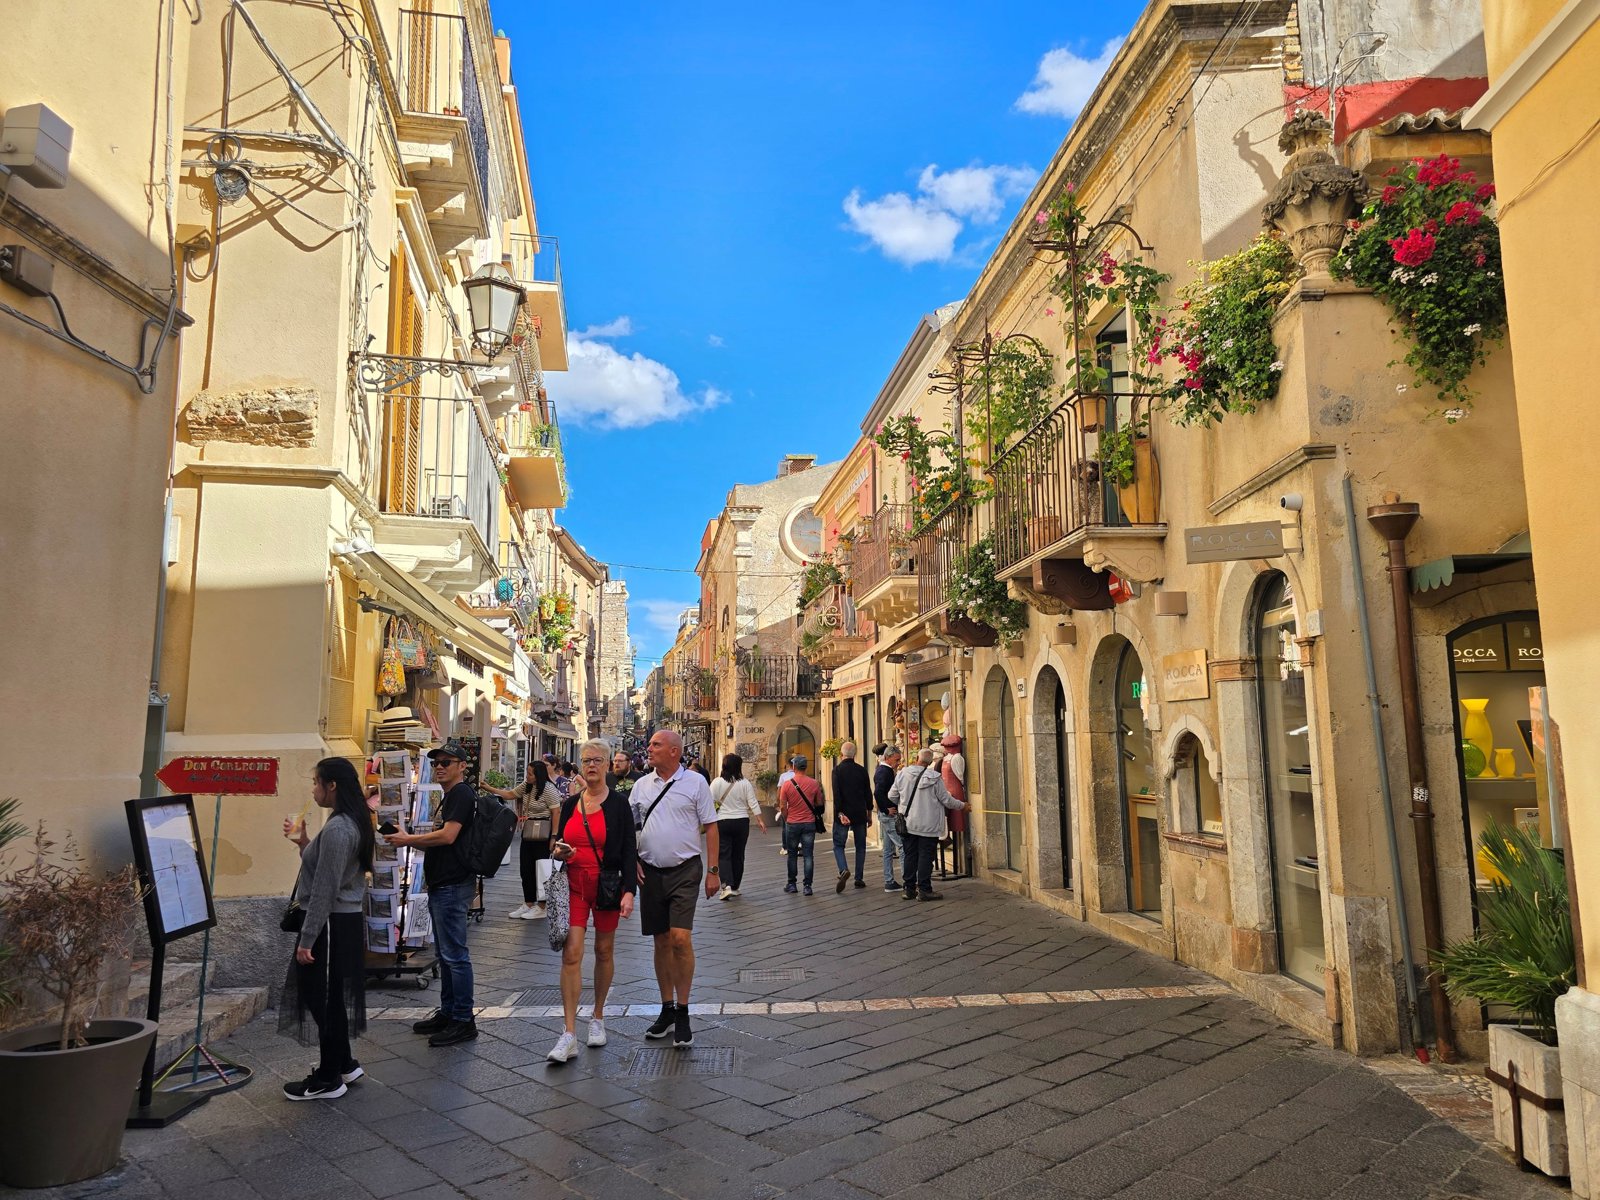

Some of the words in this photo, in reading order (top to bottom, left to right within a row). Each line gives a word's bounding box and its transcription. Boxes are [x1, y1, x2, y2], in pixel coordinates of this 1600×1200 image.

[1190, 528, 1277, 546] ROCCA
[1166, 663, 1203, 680] ROCCA
[745, 726, 765, 734] DIOR
[183, 759, 207, 771] DON
